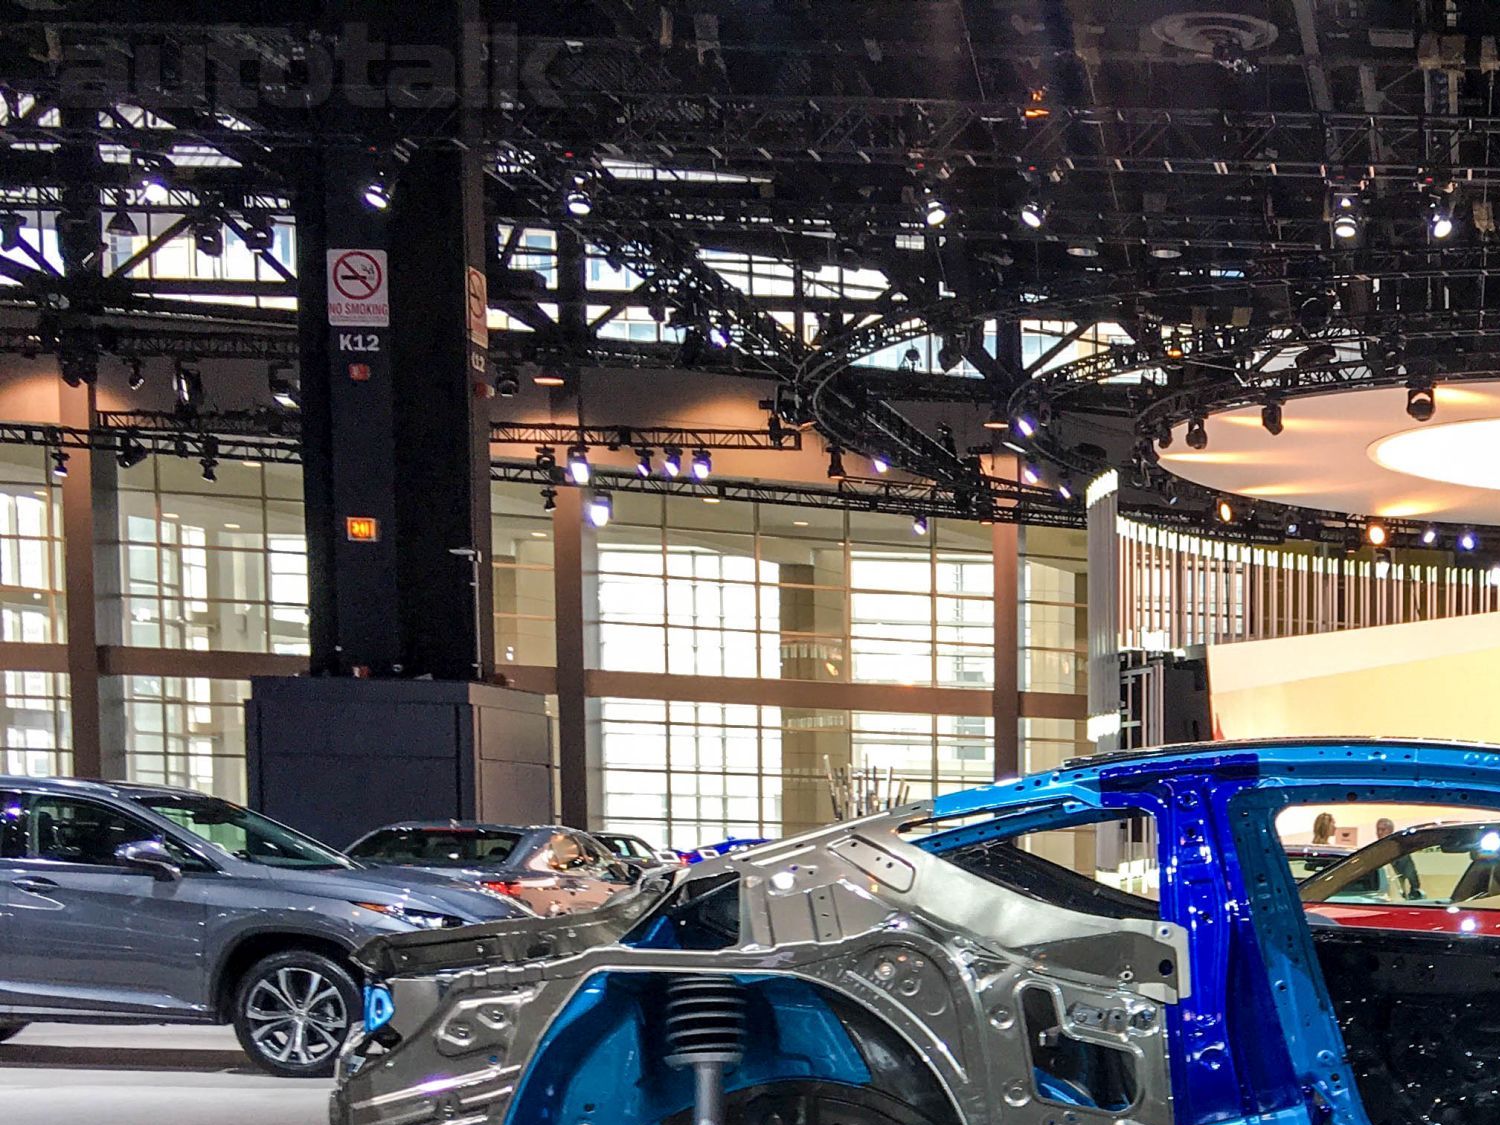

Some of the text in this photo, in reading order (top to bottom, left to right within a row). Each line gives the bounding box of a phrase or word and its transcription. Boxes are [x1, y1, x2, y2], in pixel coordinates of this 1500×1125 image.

[329, 302, 389, 315] NO SMOKING
[340, 334, 380, 351] K12
